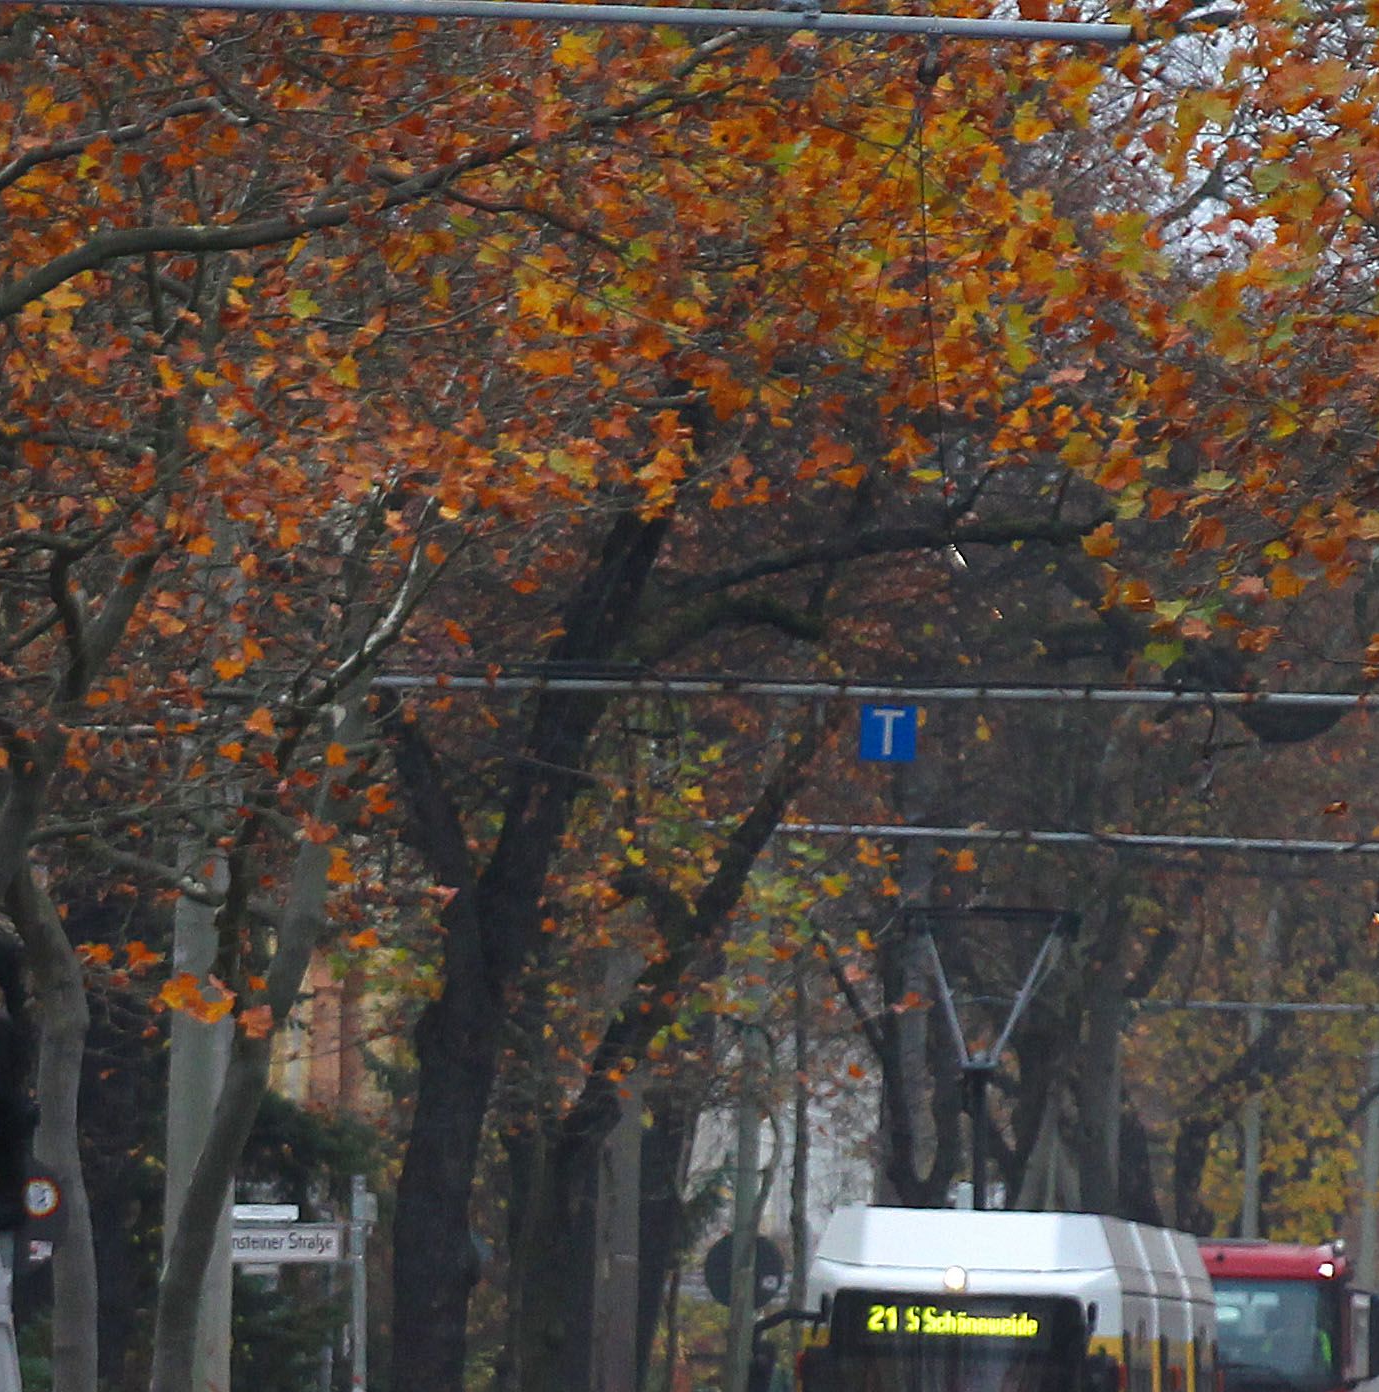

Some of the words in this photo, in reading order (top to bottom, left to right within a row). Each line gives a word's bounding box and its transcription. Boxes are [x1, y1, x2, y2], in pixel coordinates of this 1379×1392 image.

[873, 709, 906, 755] T
[232, 1233, 284, 1250] nsteiner
[288, 1231, 334, 1254] Straße
[867, 1304, 898, 1332] 21
[921, 1305, 1039, 1337] Schöneweide
